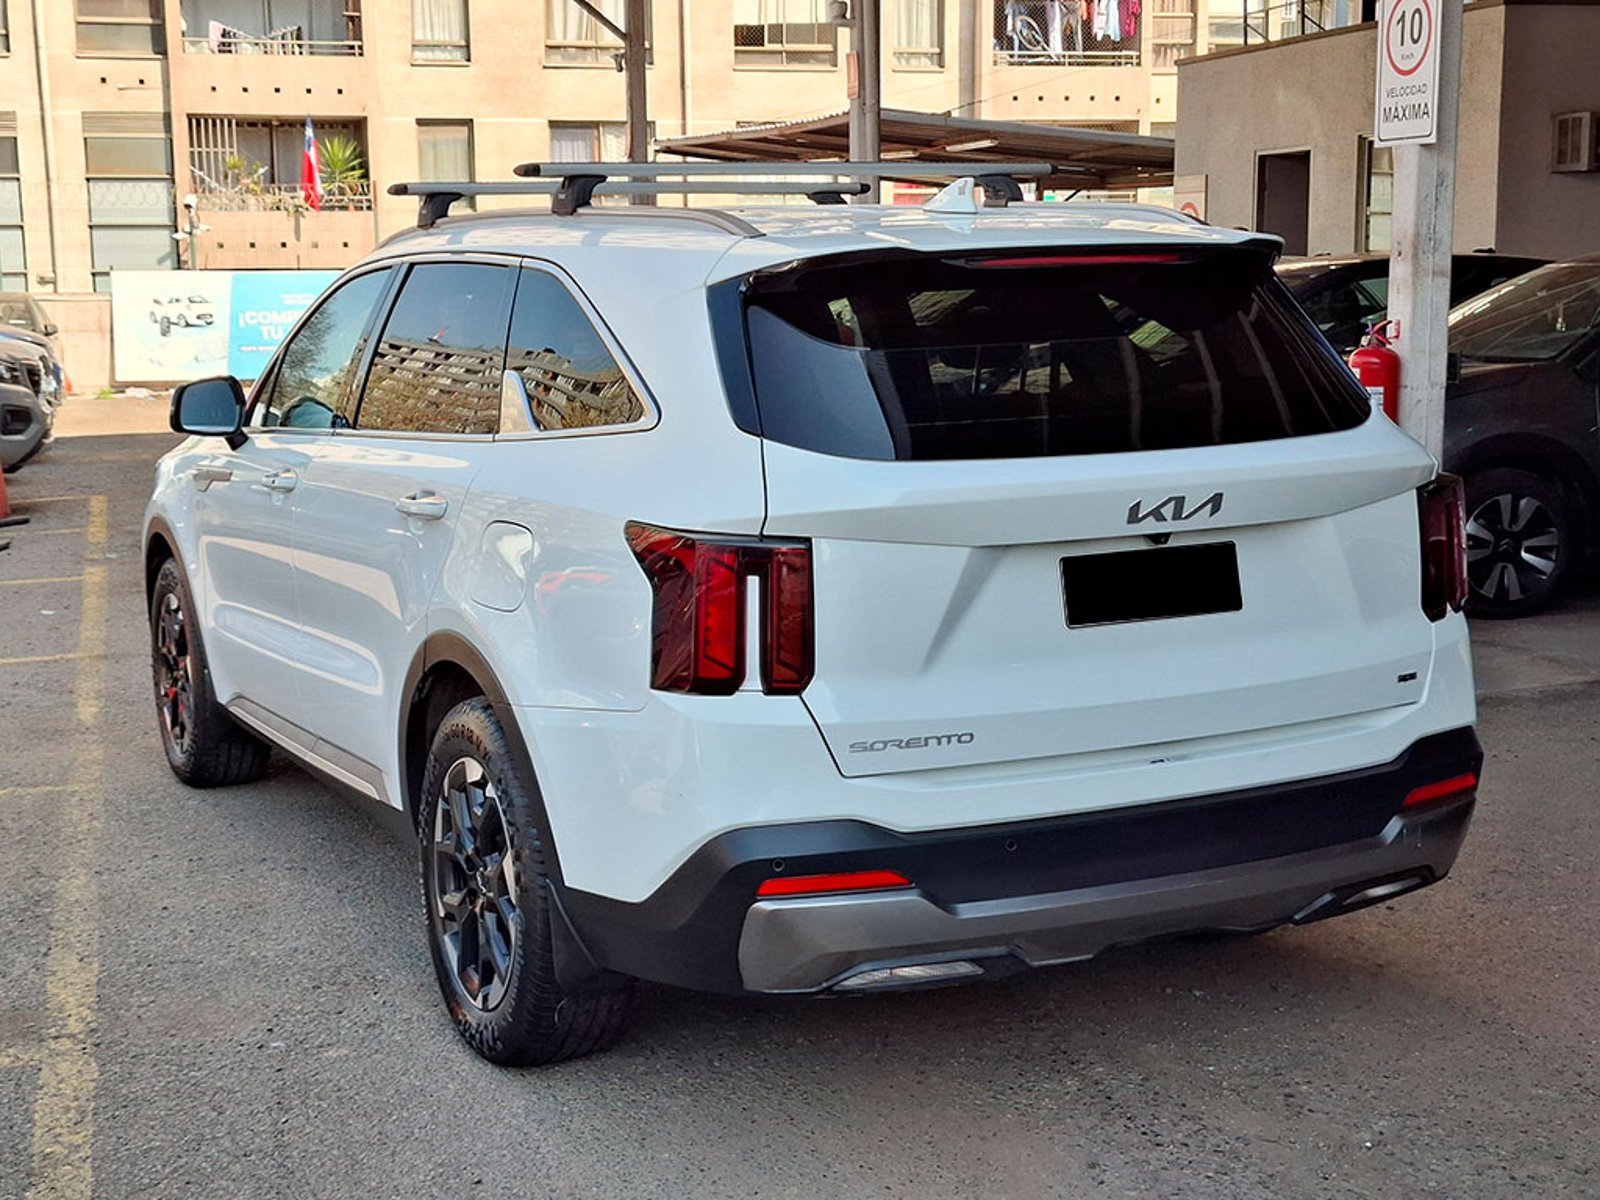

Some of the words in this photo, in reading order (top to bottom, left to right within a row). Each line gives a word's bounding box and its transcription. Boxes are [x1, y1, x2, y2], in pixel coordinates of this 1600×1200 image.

[1396, 7, 1423, 47] 10
[1385, 83, 1428, 98] VELOCIDAD
[1382, 101, 1431, 124] MÁXIMA
[260, 325, 283, 340] TU
[1126, 491, 1224, 525] KIA
[849, 732, 975, 754] SORENTO
